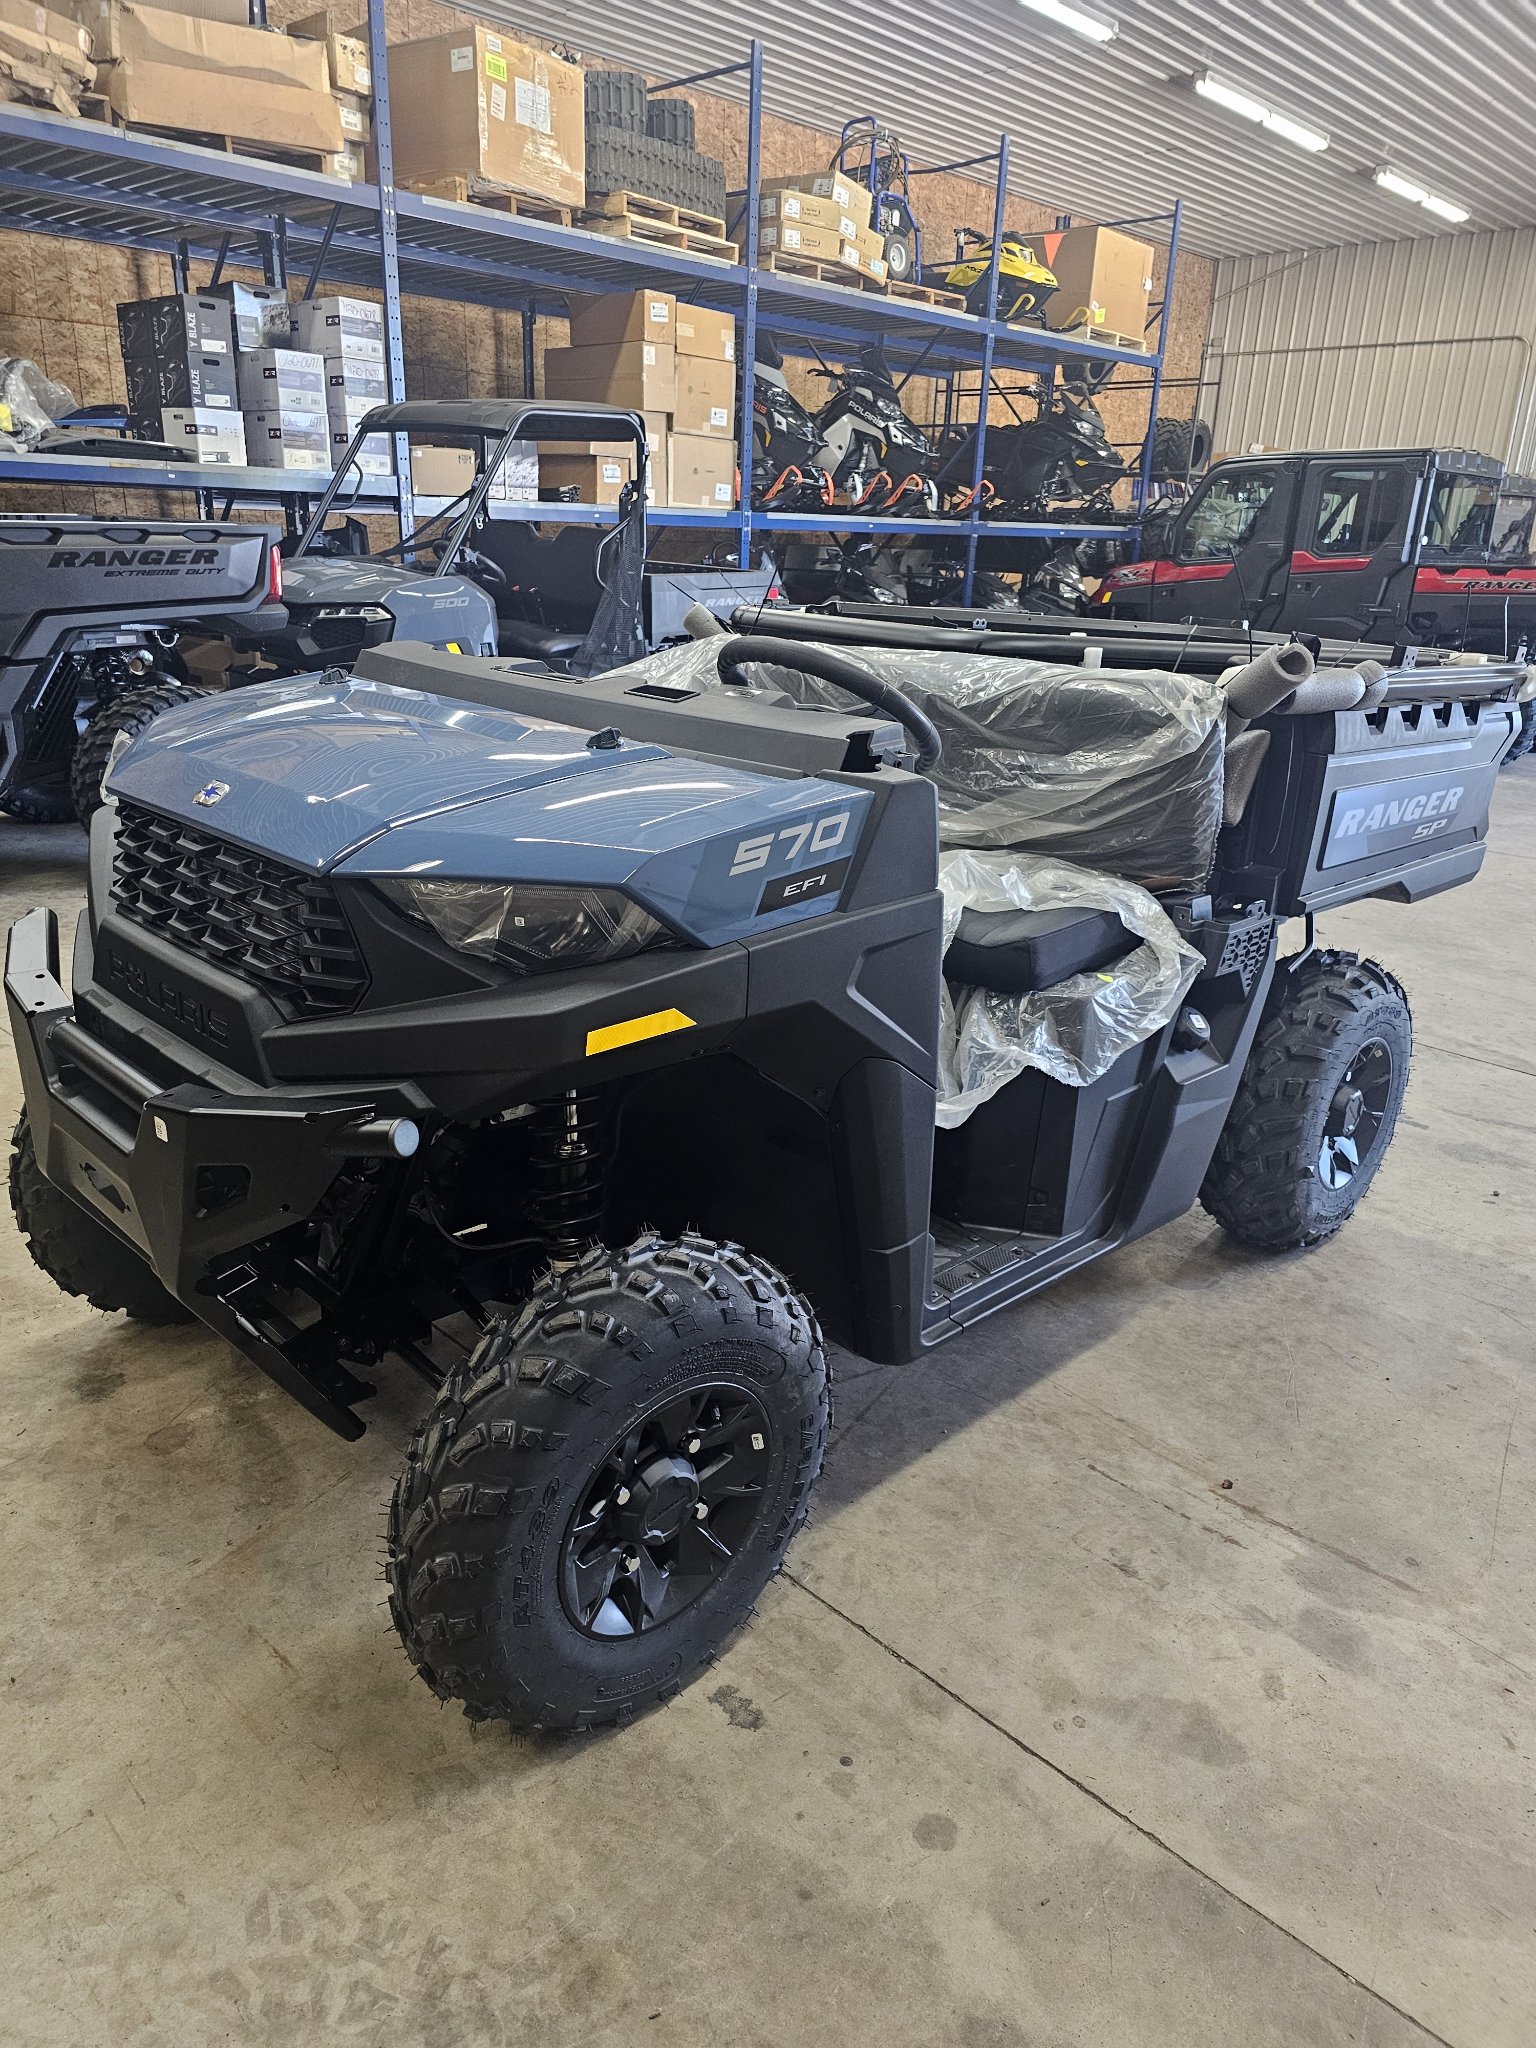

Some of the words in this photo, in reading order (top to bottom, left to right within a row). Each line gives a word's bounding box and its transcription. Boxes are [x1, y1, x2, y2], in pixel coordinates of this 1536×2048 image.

[186, 311, 198, 339] BLAZE
[190, 369, 202, 395] BLAZE
[753, 401, 768, 414] RIS
[848, 400, 888, 428] POLARIS
[47, 549, 219, 568] RANGER
[104, 569, 181, 577] EXTREME
[185, 567, 226, 576] DUTY
[1462, 581, 1536, 590] RANGE
[432, 596, 470, 609] 500
[1334, 786, 1464, 839] RANGER
[1411, 818, 1449, 840] SP
[729, 811, 851, 877] 570
[783, 874, 827, 898] EFI
[107, 950, 230, 1049] POLARIS
